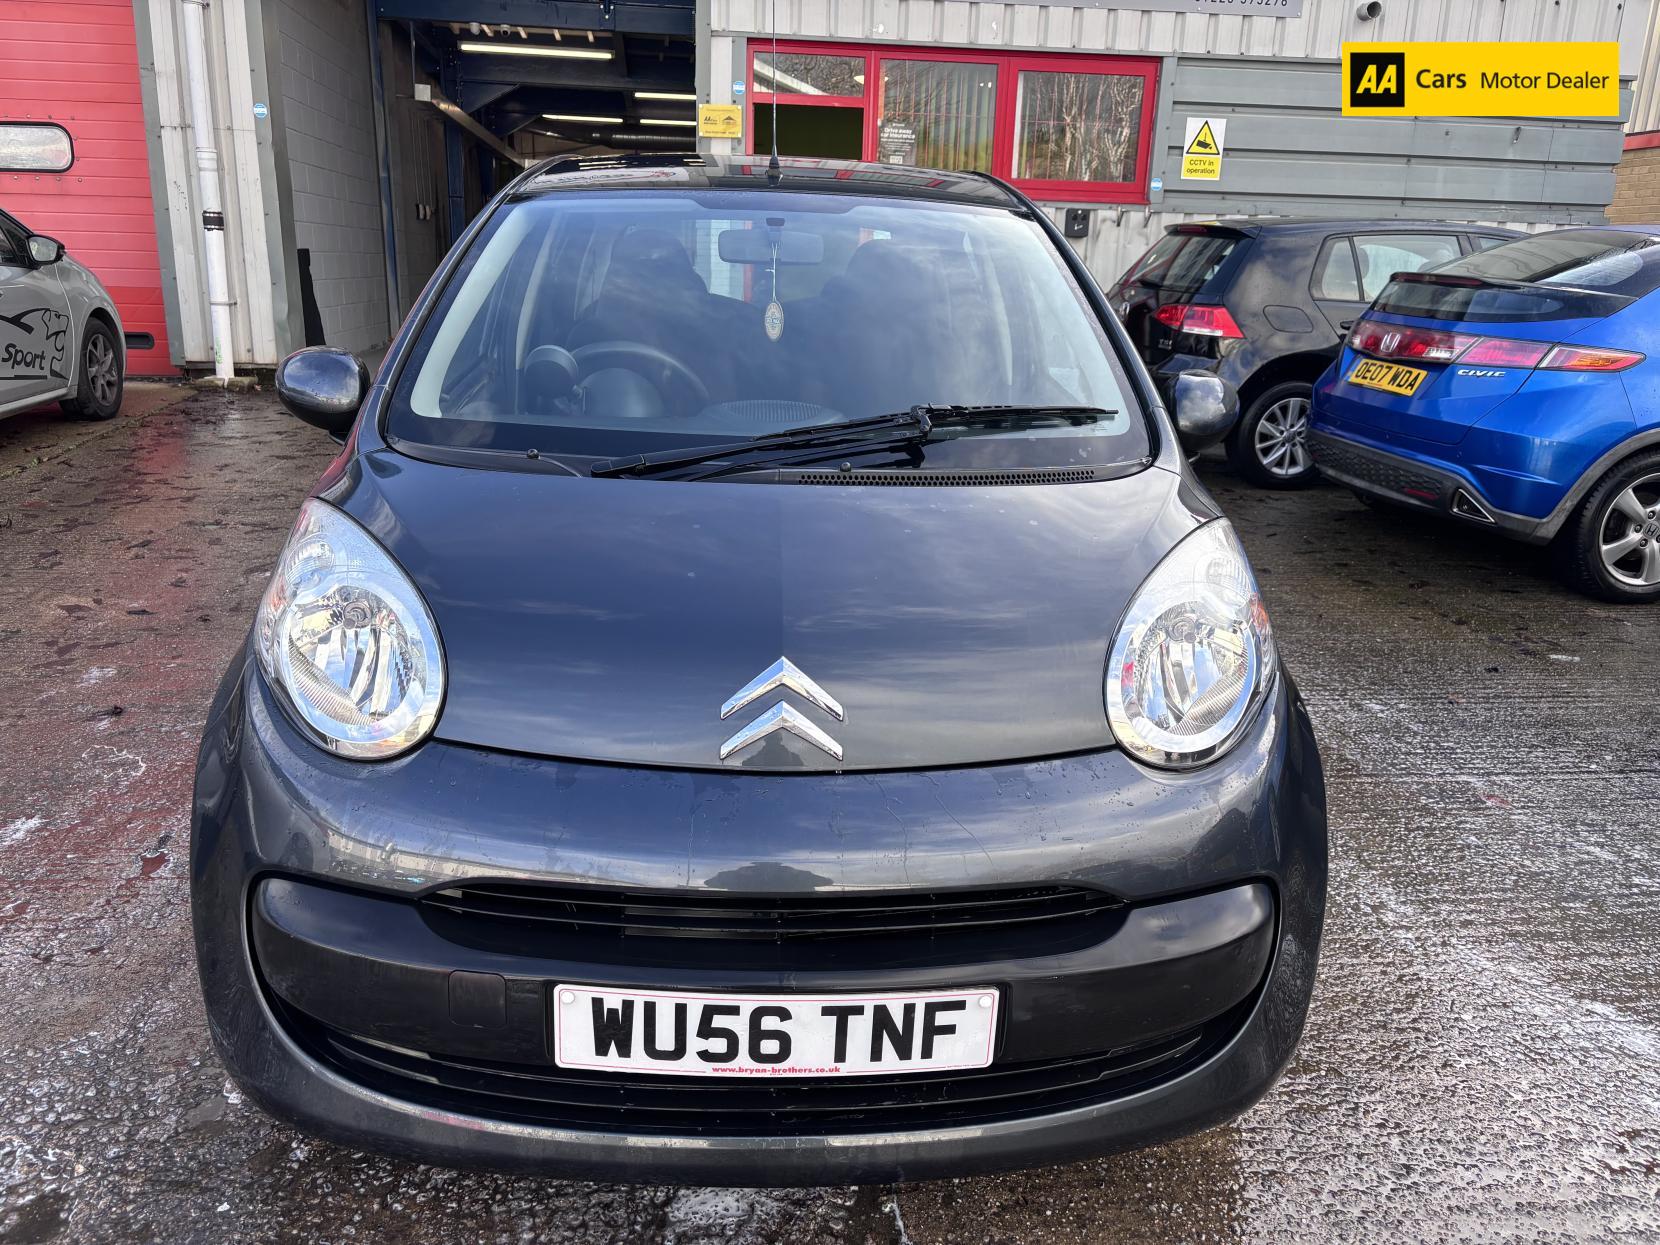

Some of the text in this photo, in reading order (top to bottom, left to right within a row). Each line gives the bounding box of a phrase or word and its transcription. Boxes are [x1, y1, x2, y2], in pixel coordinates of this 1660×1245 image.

[1, 342, 46, 371] Sport
[1355, 361, 1422, 391] OE07 WDA
[1457, 368, 1507, 378] CIVIC
[590, 996, 967, 1065] WU56 TNF
[711, 1065, 841, 1075] www.bryan-brothers.co.uk
